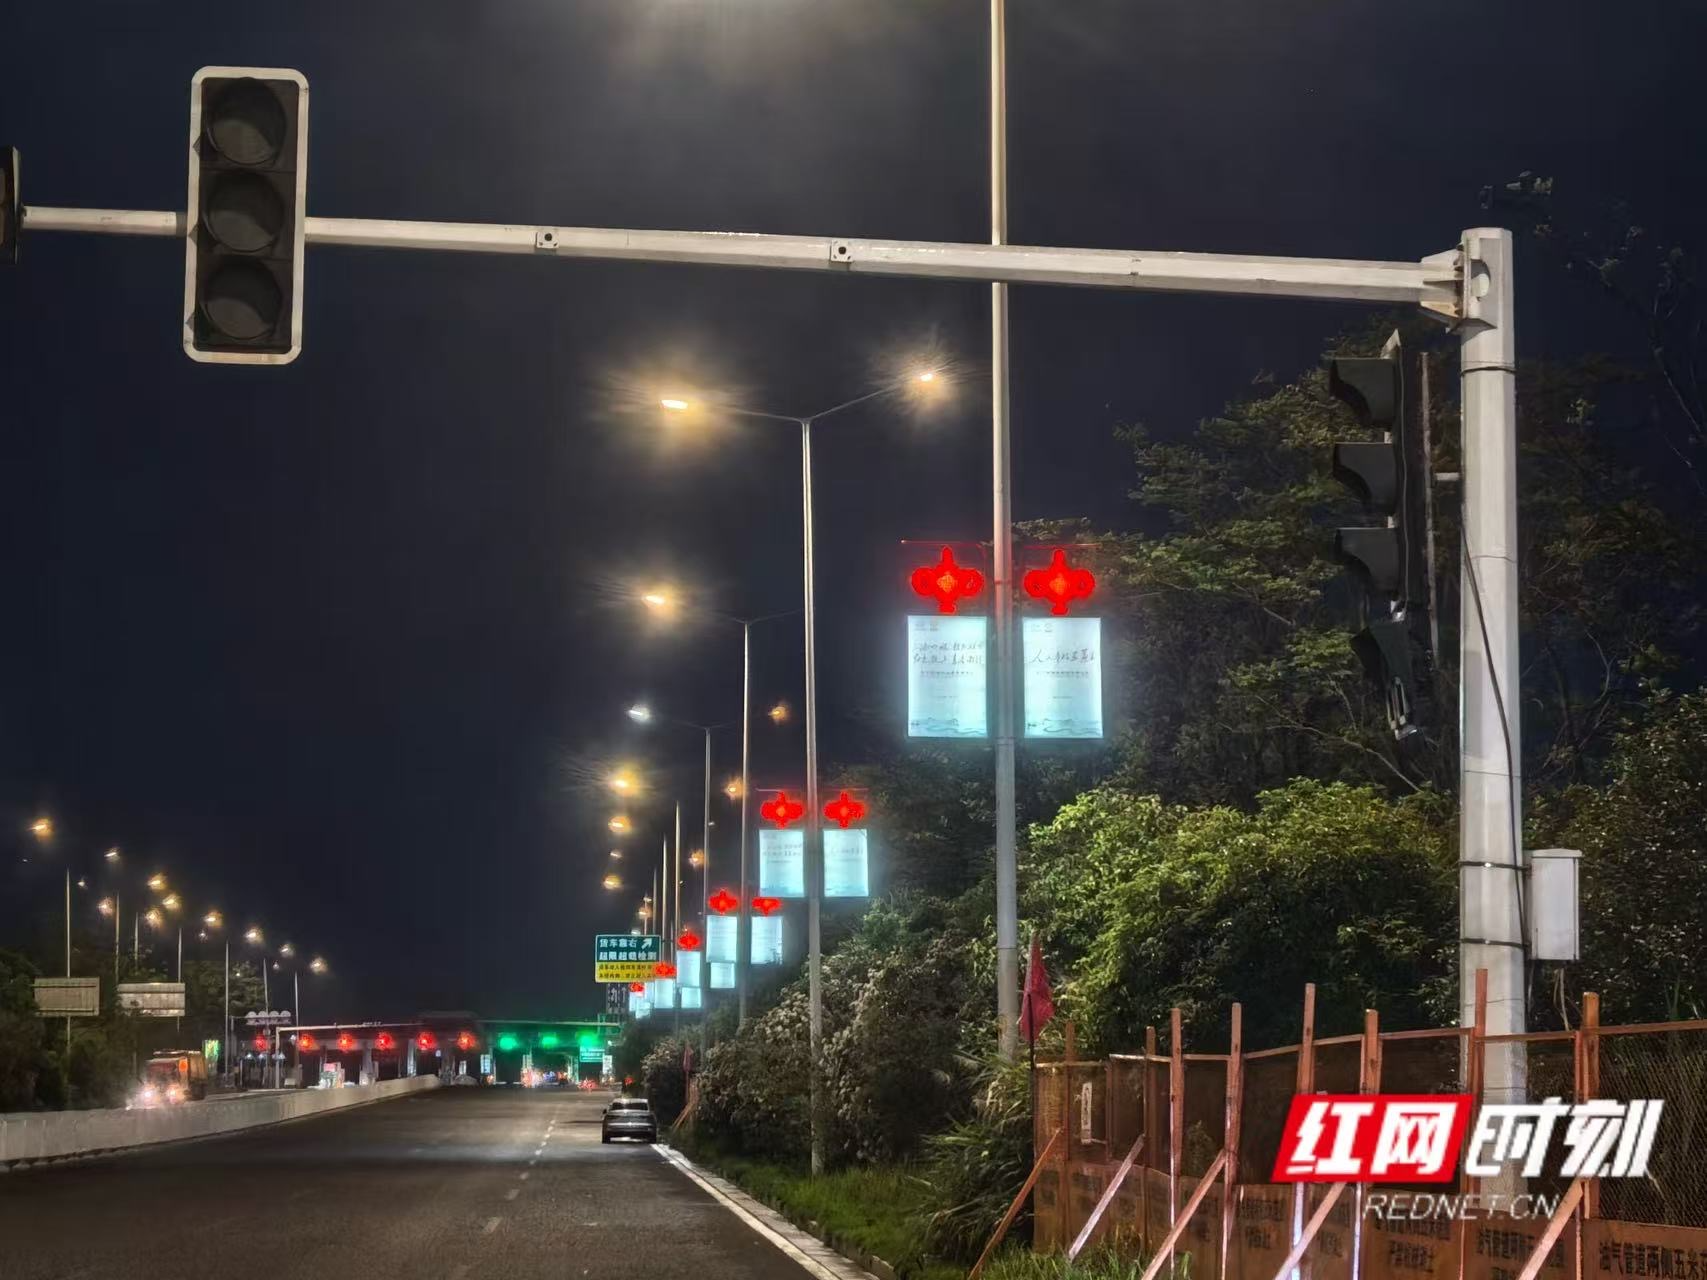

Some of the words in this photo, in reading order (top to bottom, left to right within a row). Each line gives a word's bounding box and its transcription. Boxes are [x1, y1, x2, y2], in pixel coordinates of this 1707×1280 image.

[599, 938, 637, 948] 货车靠右
[599, 951, 657, 961] 超限超载检测
